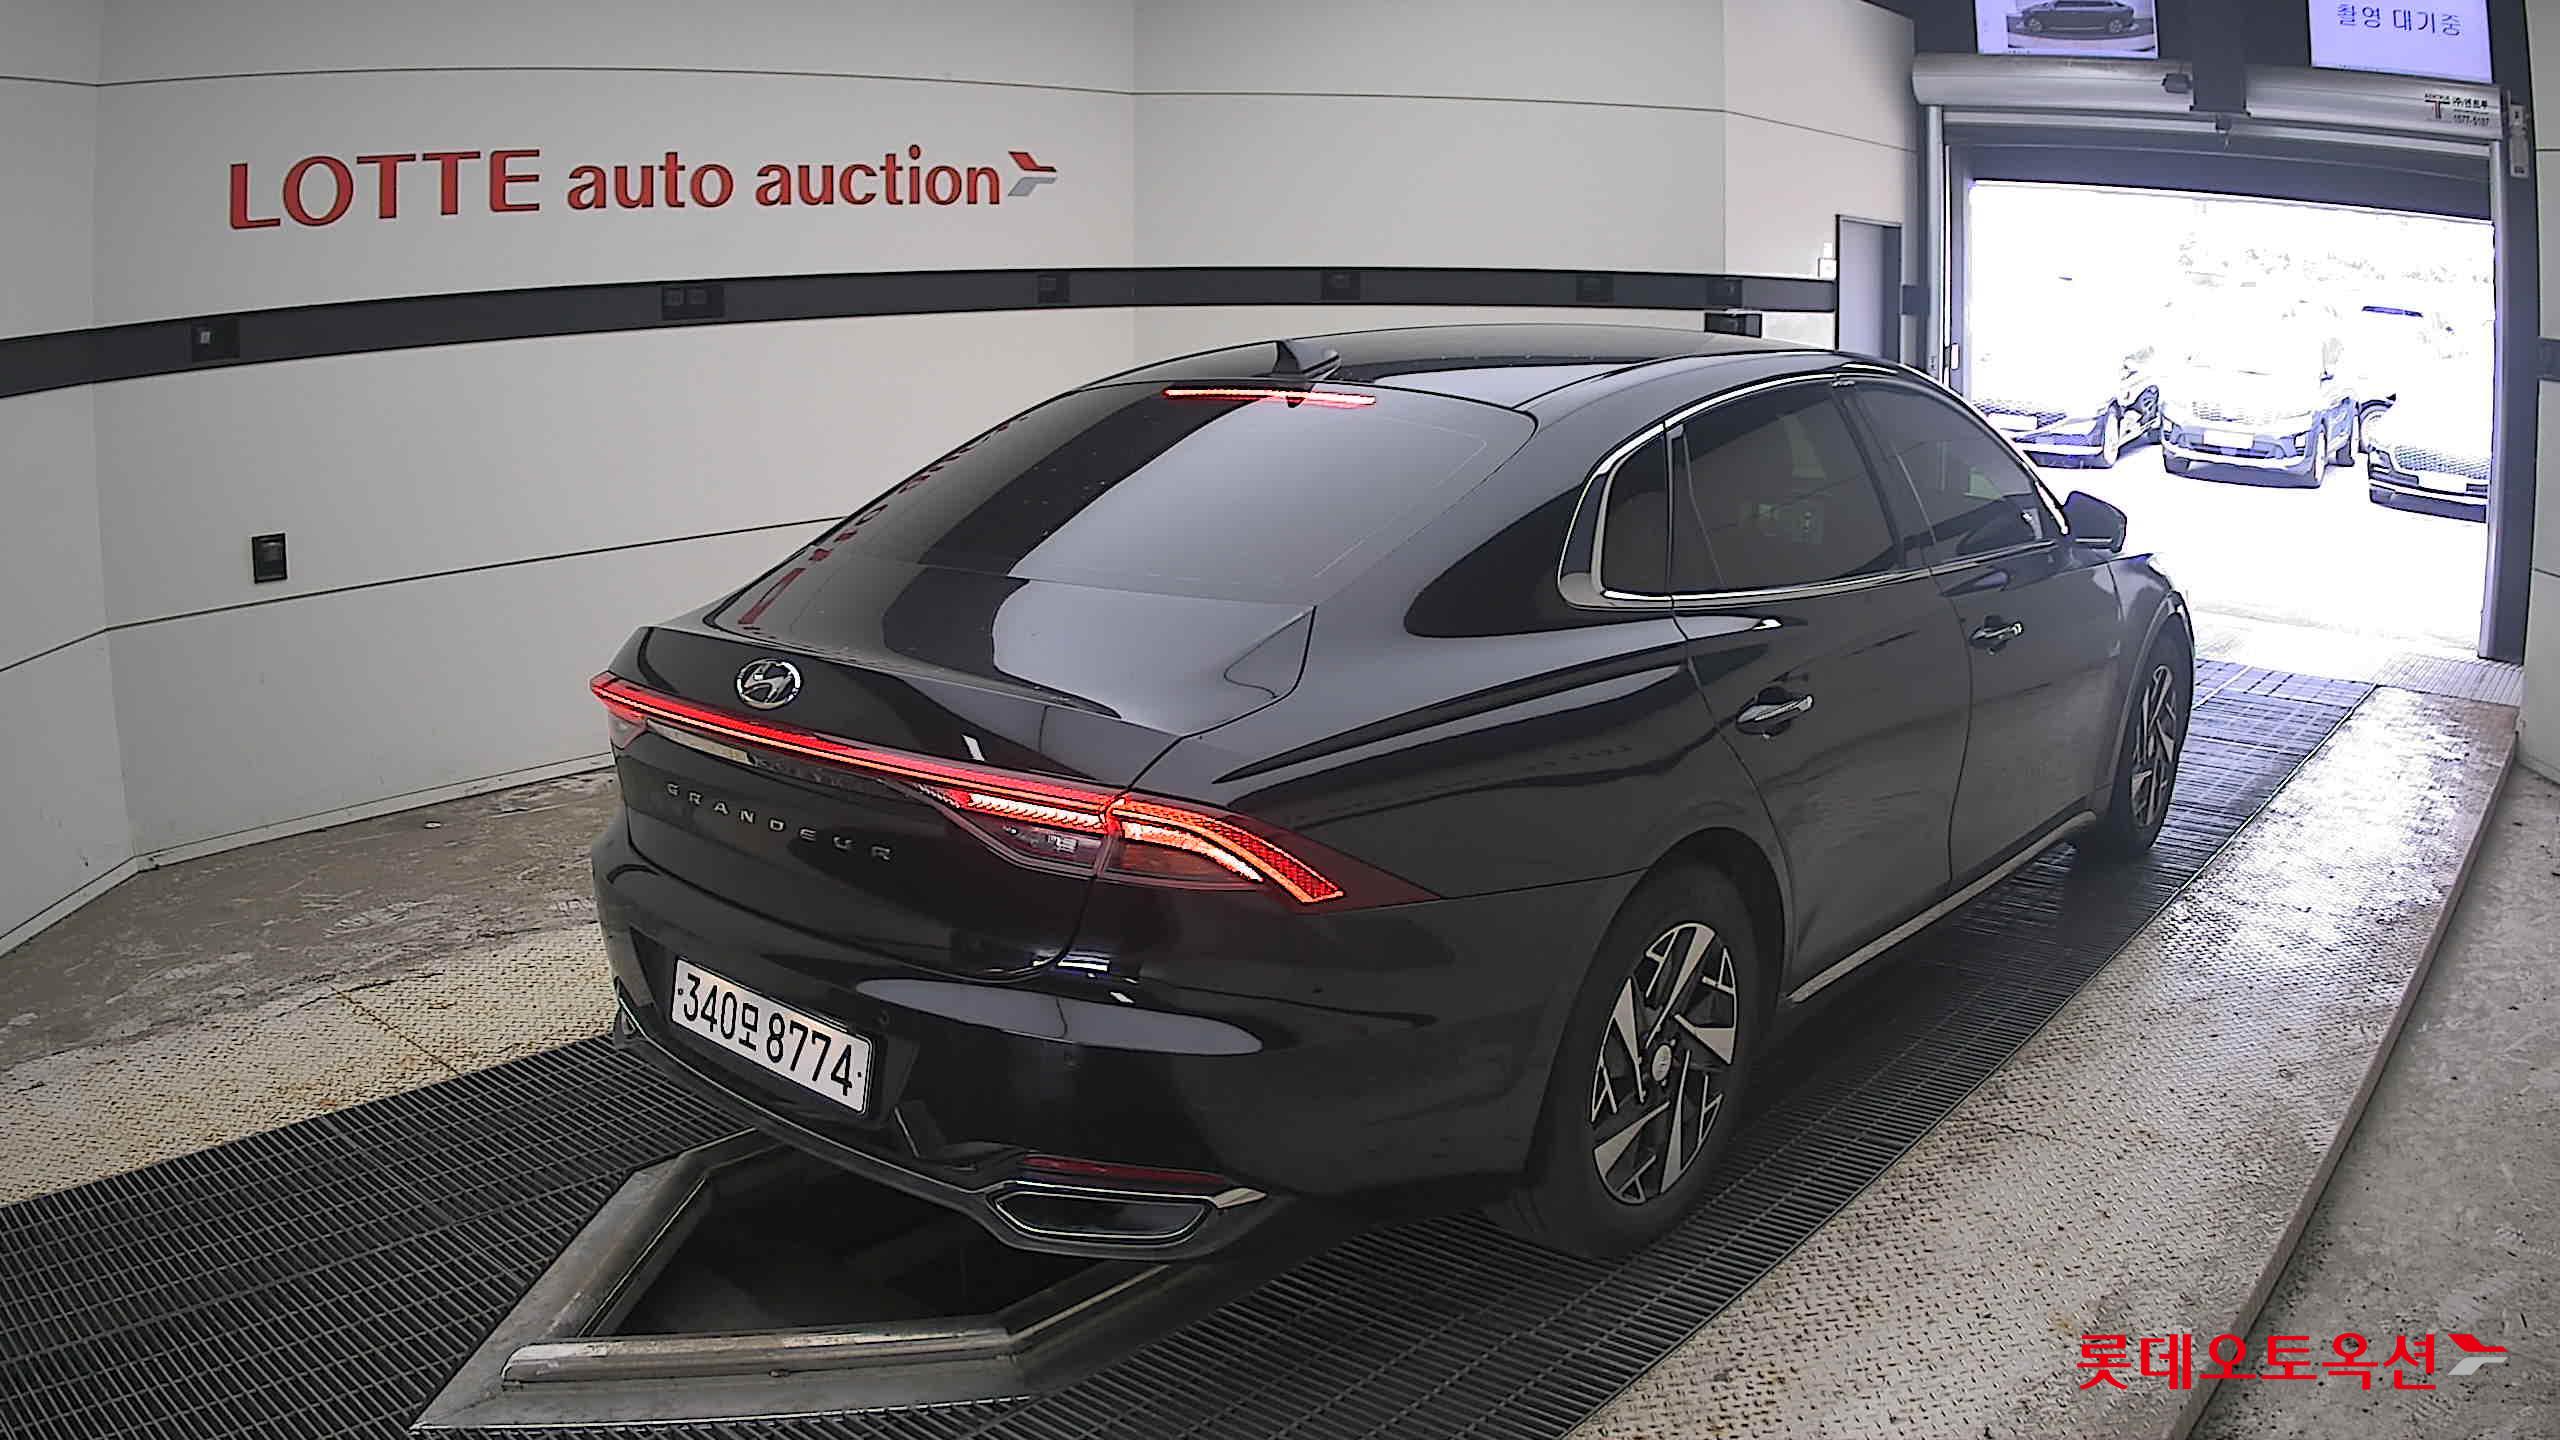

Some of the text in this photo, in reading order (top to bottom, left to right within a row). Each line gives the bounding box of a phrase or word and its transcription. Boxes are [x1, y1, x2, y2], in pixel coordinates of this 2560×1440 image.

[2337, 3, 2461, 36] 촬영 대기중
[230, 144, 1001, 230] LOTTE auto auction
[666, 782, 891, 861] GRANDEUR
[683, 972, 853, 1097] 340모 8774
